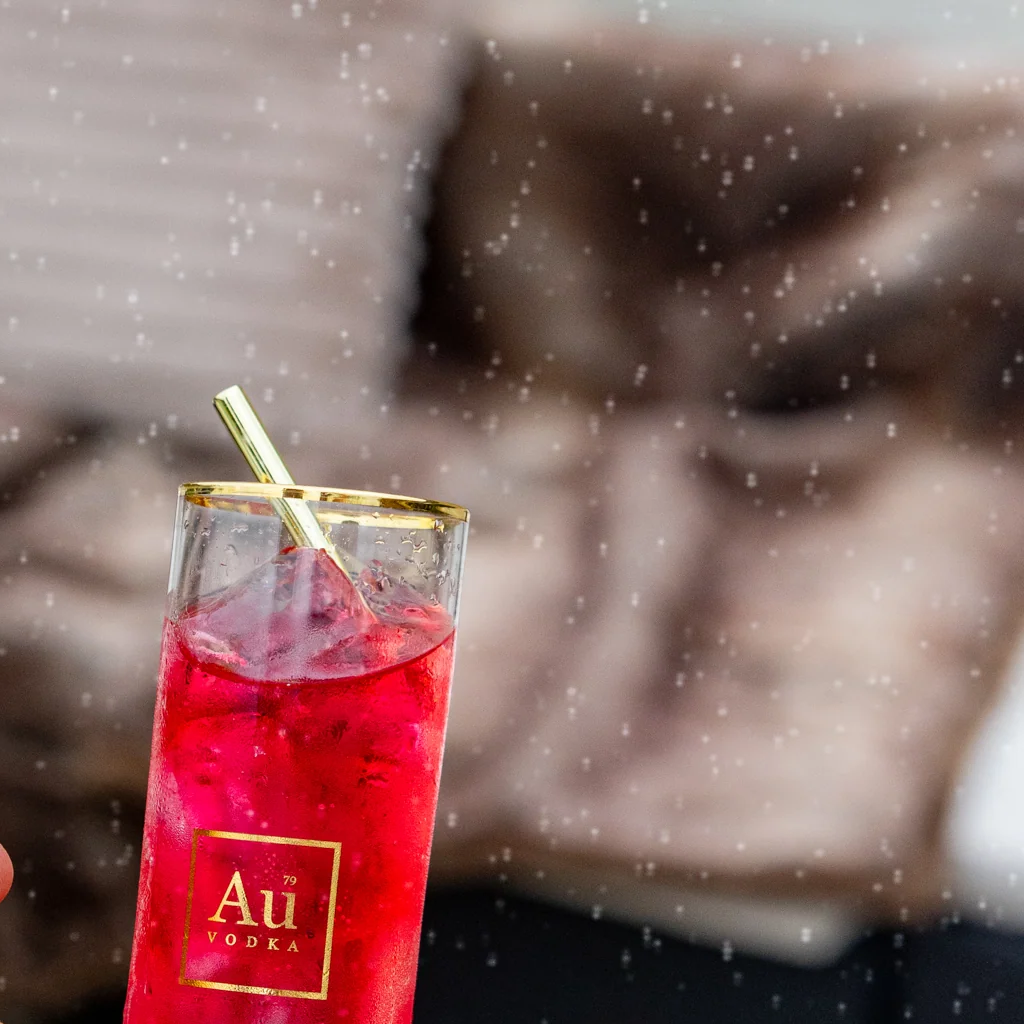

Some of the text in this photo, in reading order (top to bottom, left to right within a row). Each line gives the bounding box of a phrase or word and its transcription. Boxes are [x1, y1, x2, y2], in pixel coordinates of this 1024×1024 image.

[283, 875, 297, 886] 79
[208, 870, 298, 930] Au
[207, 931, 299, 953] VODKA
